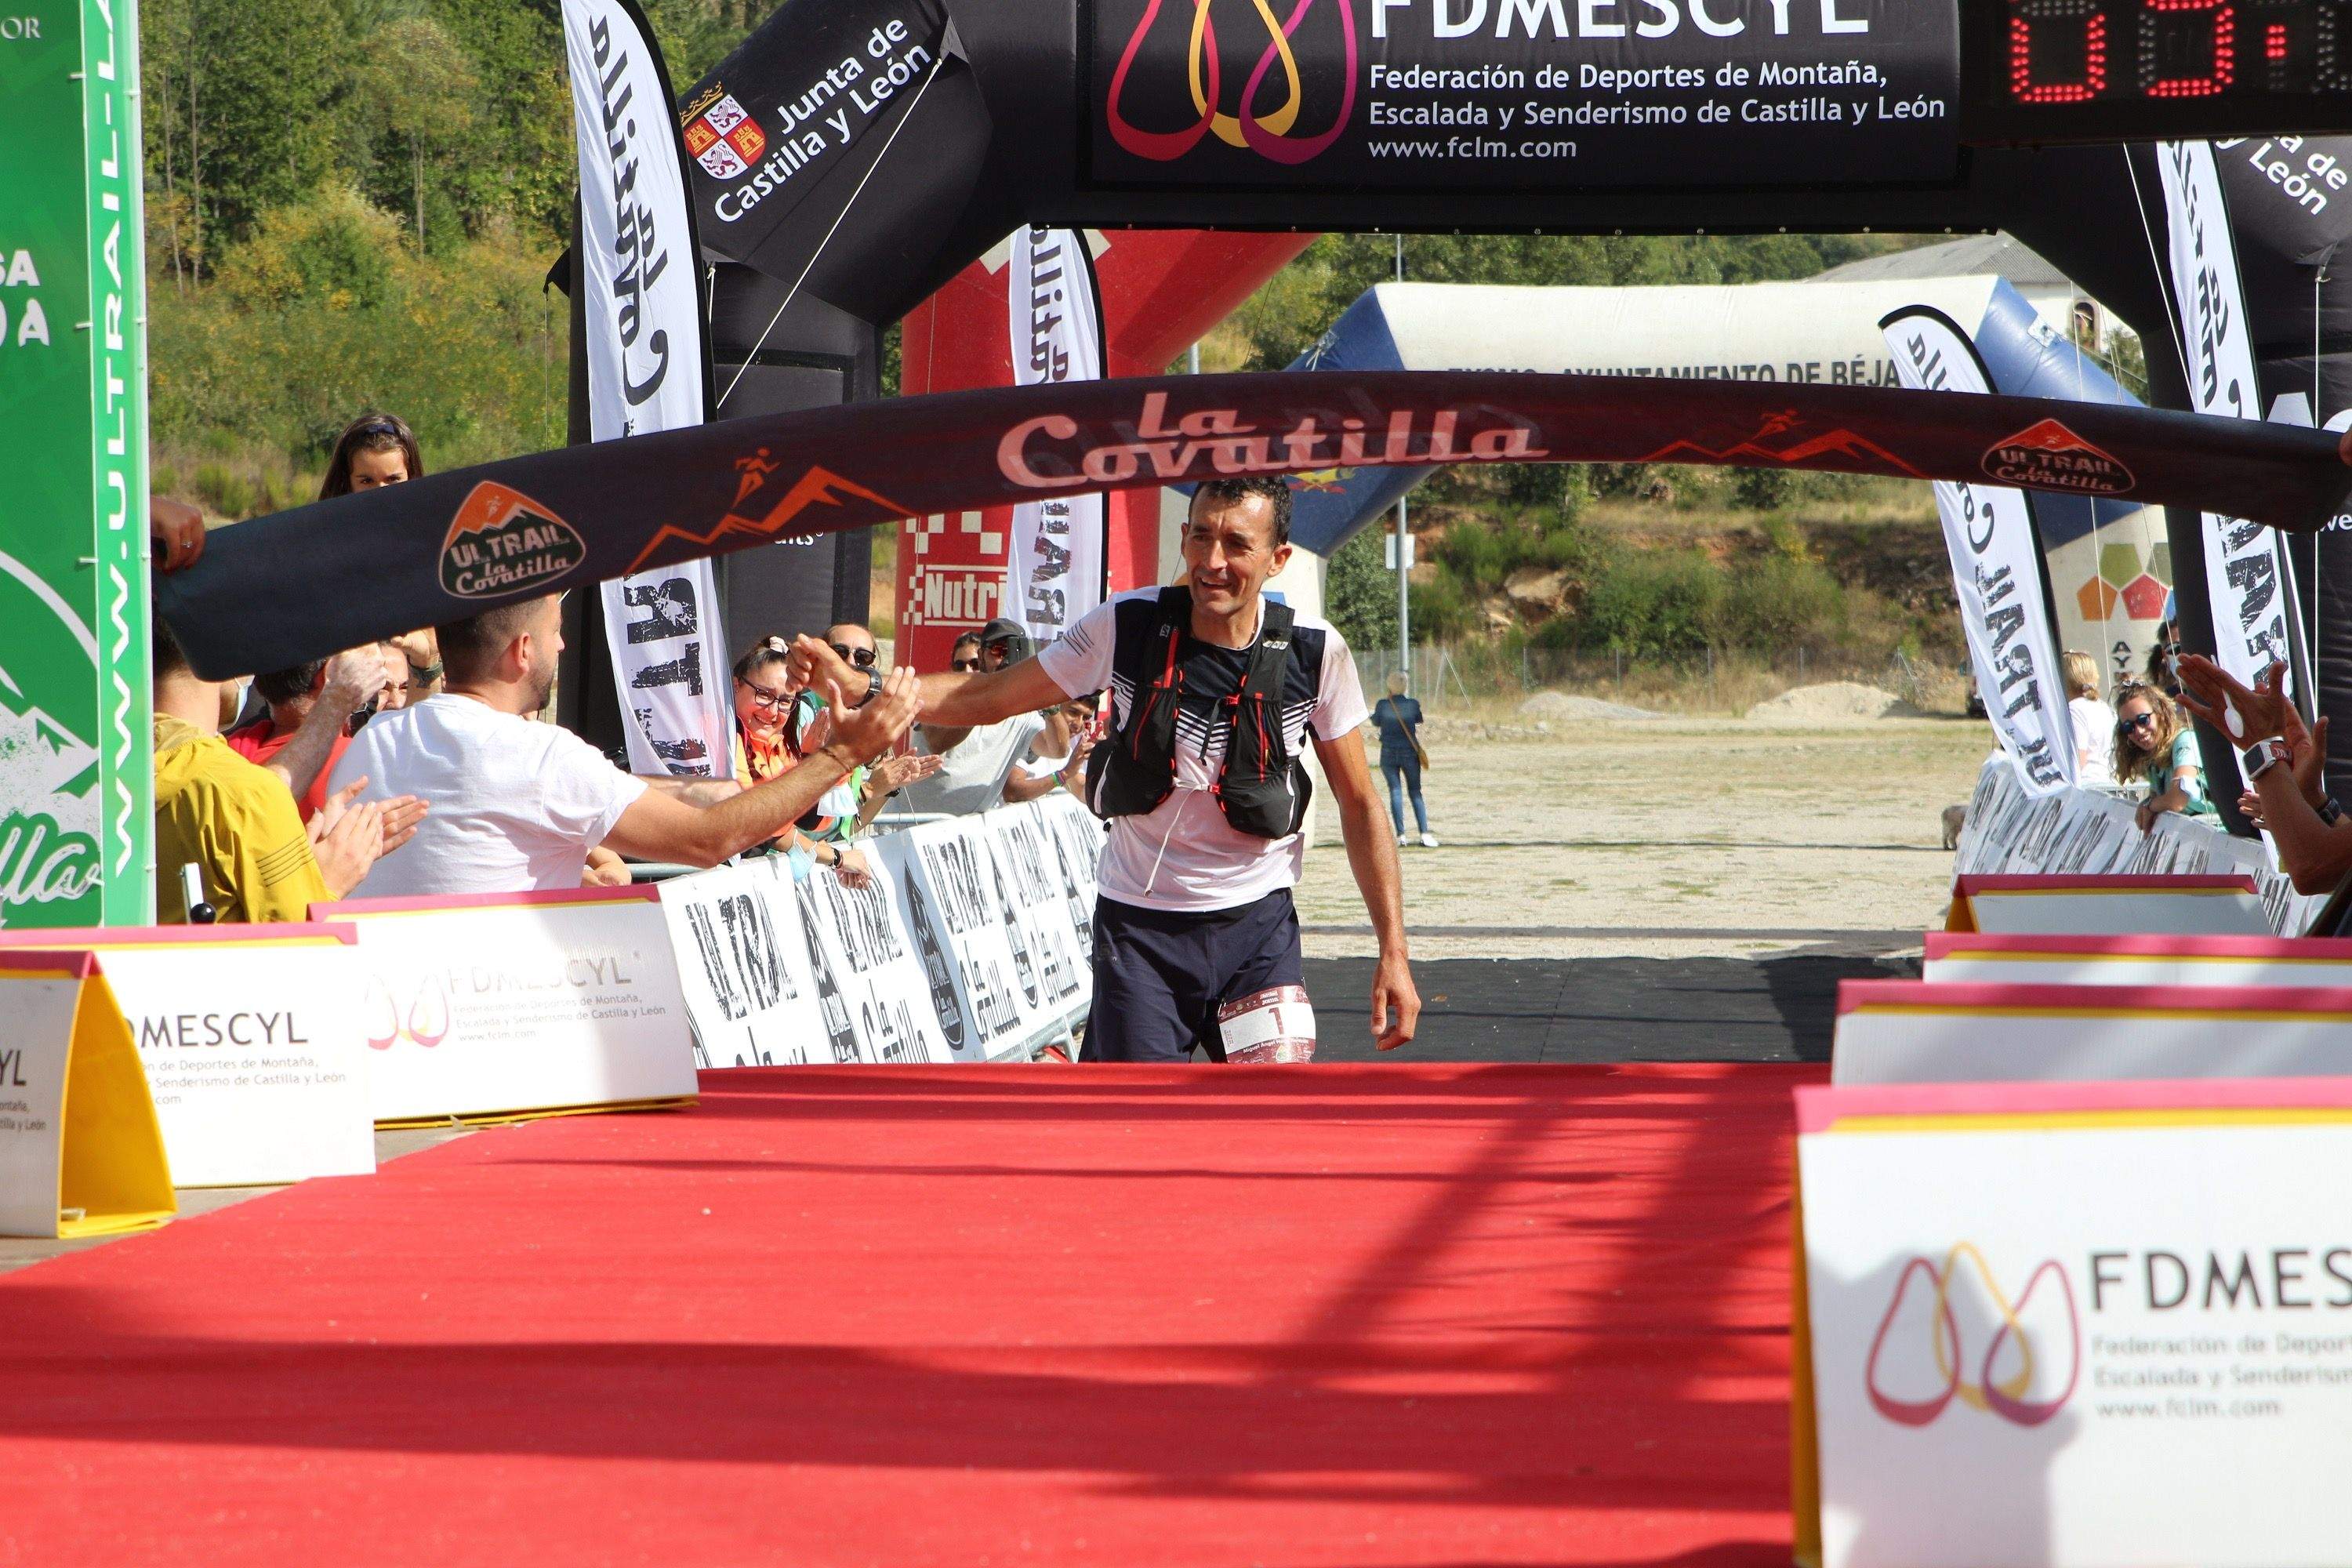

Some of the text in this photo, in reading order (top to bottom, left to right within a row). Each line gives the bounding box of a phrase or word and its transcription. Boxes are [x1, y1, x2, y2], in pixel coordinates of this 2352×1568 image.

[777, 20, 908, 135] Junta de
[1370, 60, 1887, 94] Federación de Deportes de Montaña,
[1370, 94, 1945, 130] Escalada y Senderismo de Castilla y León
[714, 45, 931, 223] Castilla y León
[1368, 136, 1577, 158] www.fclm.com
[2249, 141, 2328, 216] León
[2307, 153, 2348, 191] de
[996, 410, 1550, 488] Covatilla
[2000, 449, 2120, 476] ULTRAIL
[451, 524, 570, 568] ULTRAIL
[456, 554, 572, 594] Covatilla
[575, 1010, 589, 1021] de
[591, 1007, 629, 1020] Castilla
[632, 1009, 638, 1018] y
[641, 1005, 666, 1016] León
[580, 996, 592, 1006] de
[128, 1011, 309, 1049] MESCYL
[1268, 1007, 1285, 1036] 1
[156, 1072, 347, 1089] Senderismo de Castilla y León
[159, 1058, 176, 1072] de
[180, 1059, 237, 1073] Deportes
[241, 1058, 256, 1069] de
[2091, 1247, 2352, 1310] FDMES
[2092, 1335, 2227, 1355] Federación
[2237, 1334, 2266, 1353] de
[2094, 1365, 2199, 1386] Escalada
